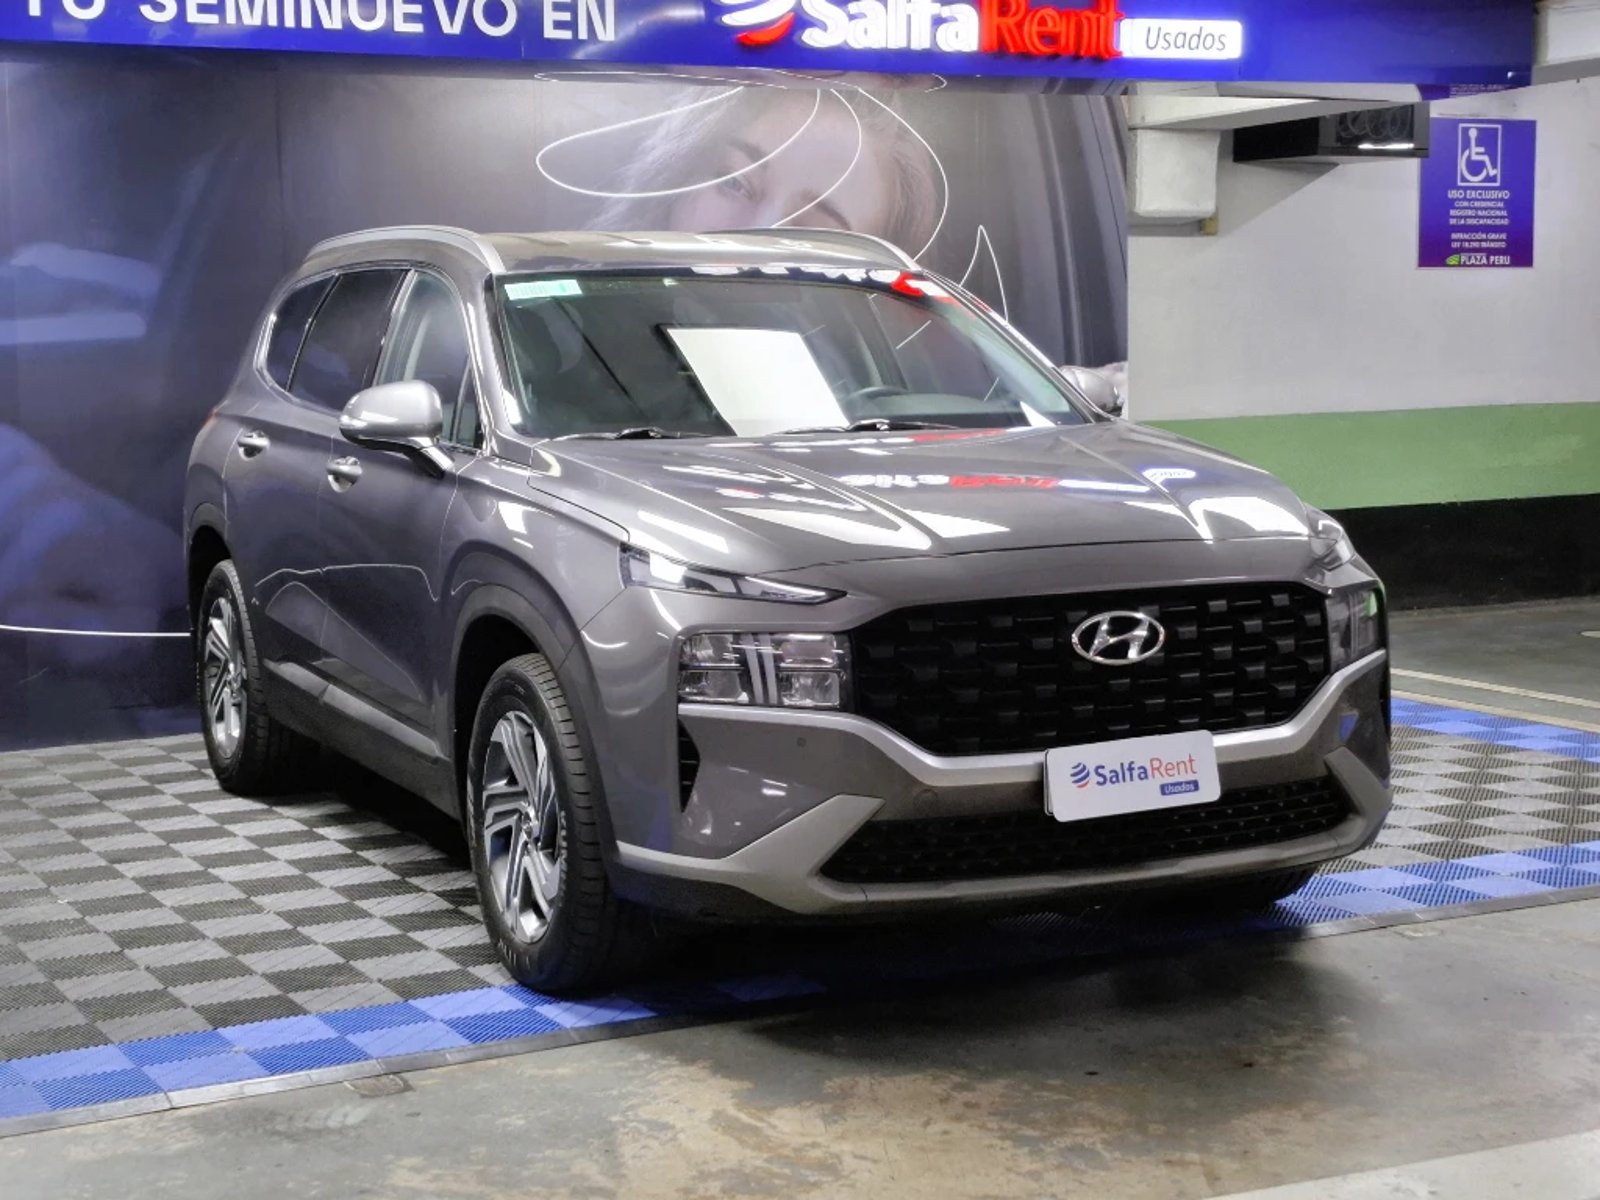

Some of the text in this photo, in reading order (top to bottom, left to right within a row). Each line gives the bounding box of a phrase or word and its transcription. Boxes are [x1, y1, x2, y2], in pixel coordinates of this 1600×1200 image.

[543, 0, 616, 41] EN
[1145, 26, 1227, 51] Usados
[1448, 190, 1510, 199] USO EXCLUSIVO
[1461, 255, 1510, 265] PLAZA PERU
[1094, 753, 1197, 786] SalfaRent
[1164, 781, 1195, 794] Usados
